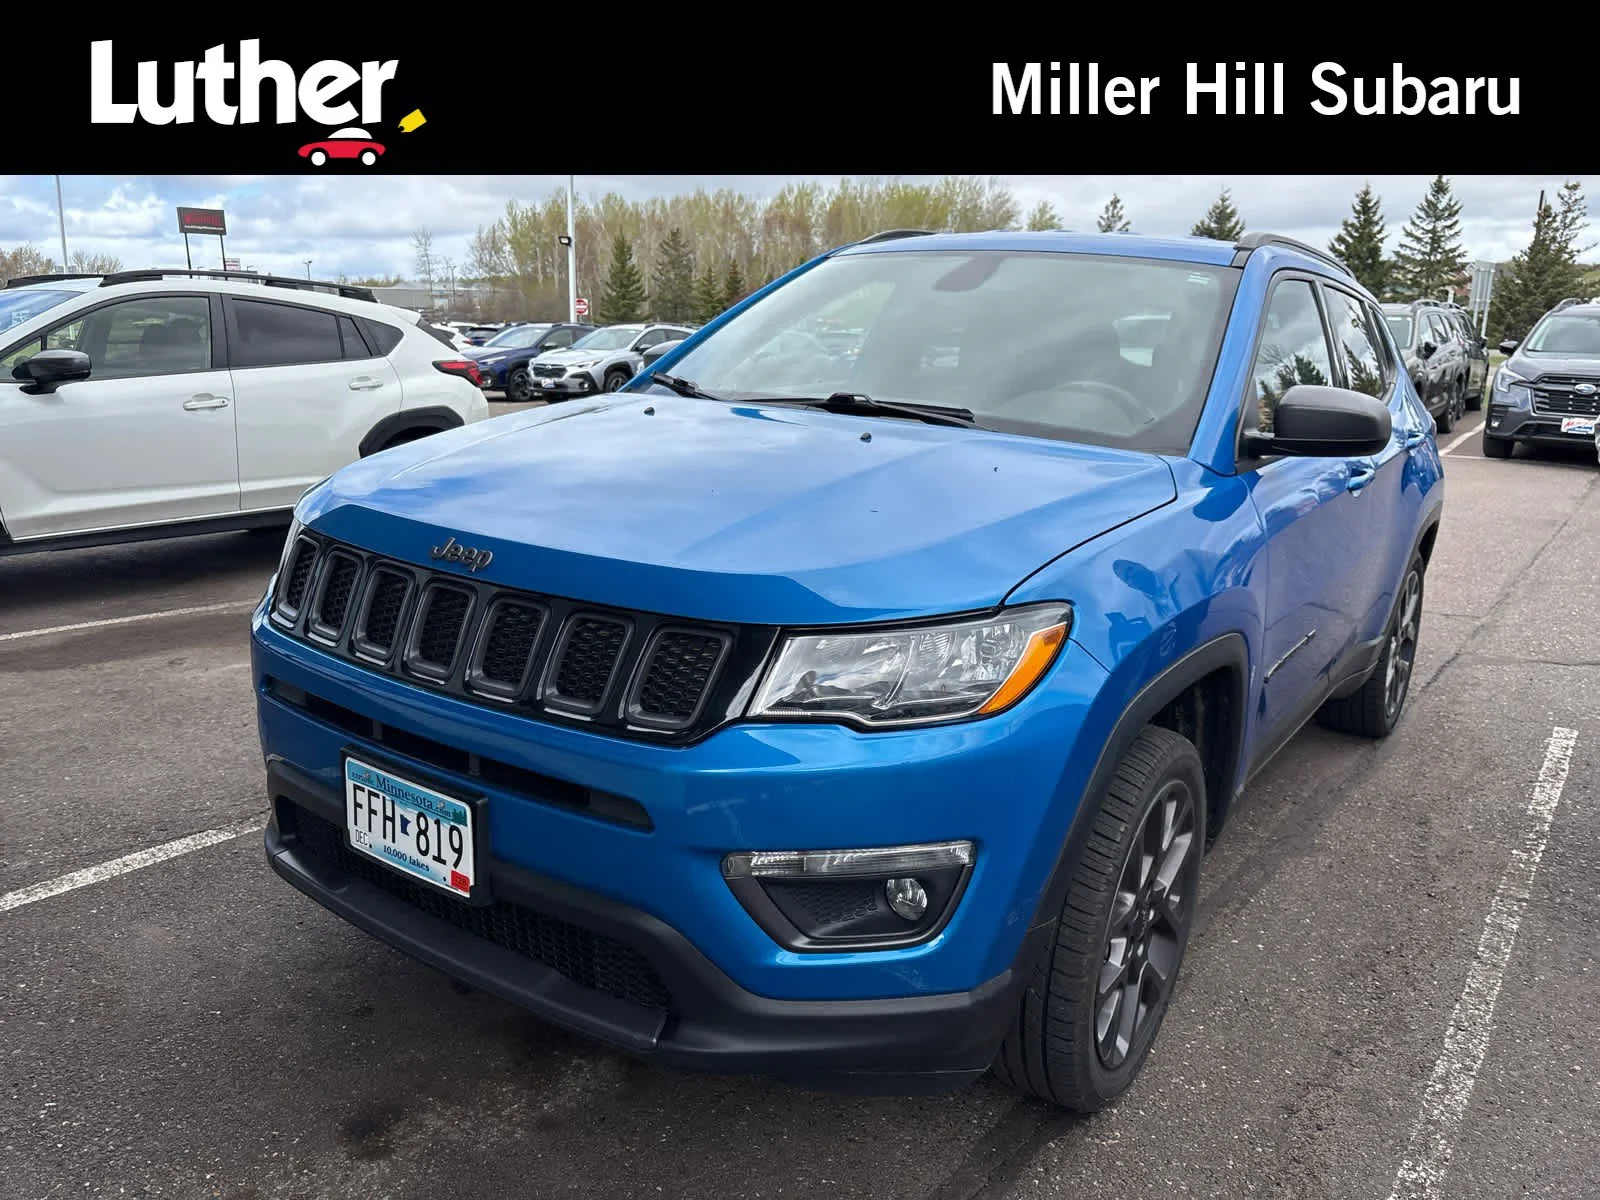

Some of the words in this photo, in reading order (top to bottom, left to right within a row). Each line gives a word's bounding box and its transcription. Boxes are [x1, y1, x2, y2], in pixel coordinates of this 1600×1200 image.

[432, 536, 494, 572] Jeep
[376, 775, 433, 808] Minnesota
[353, 784, 396, 844] FFH
[416, 812, 464, 870] 819
[355, 829, 369, 846] DEC
[383, 845, 408, 863] 10,000
[409, 856, 430, 872] lakes
